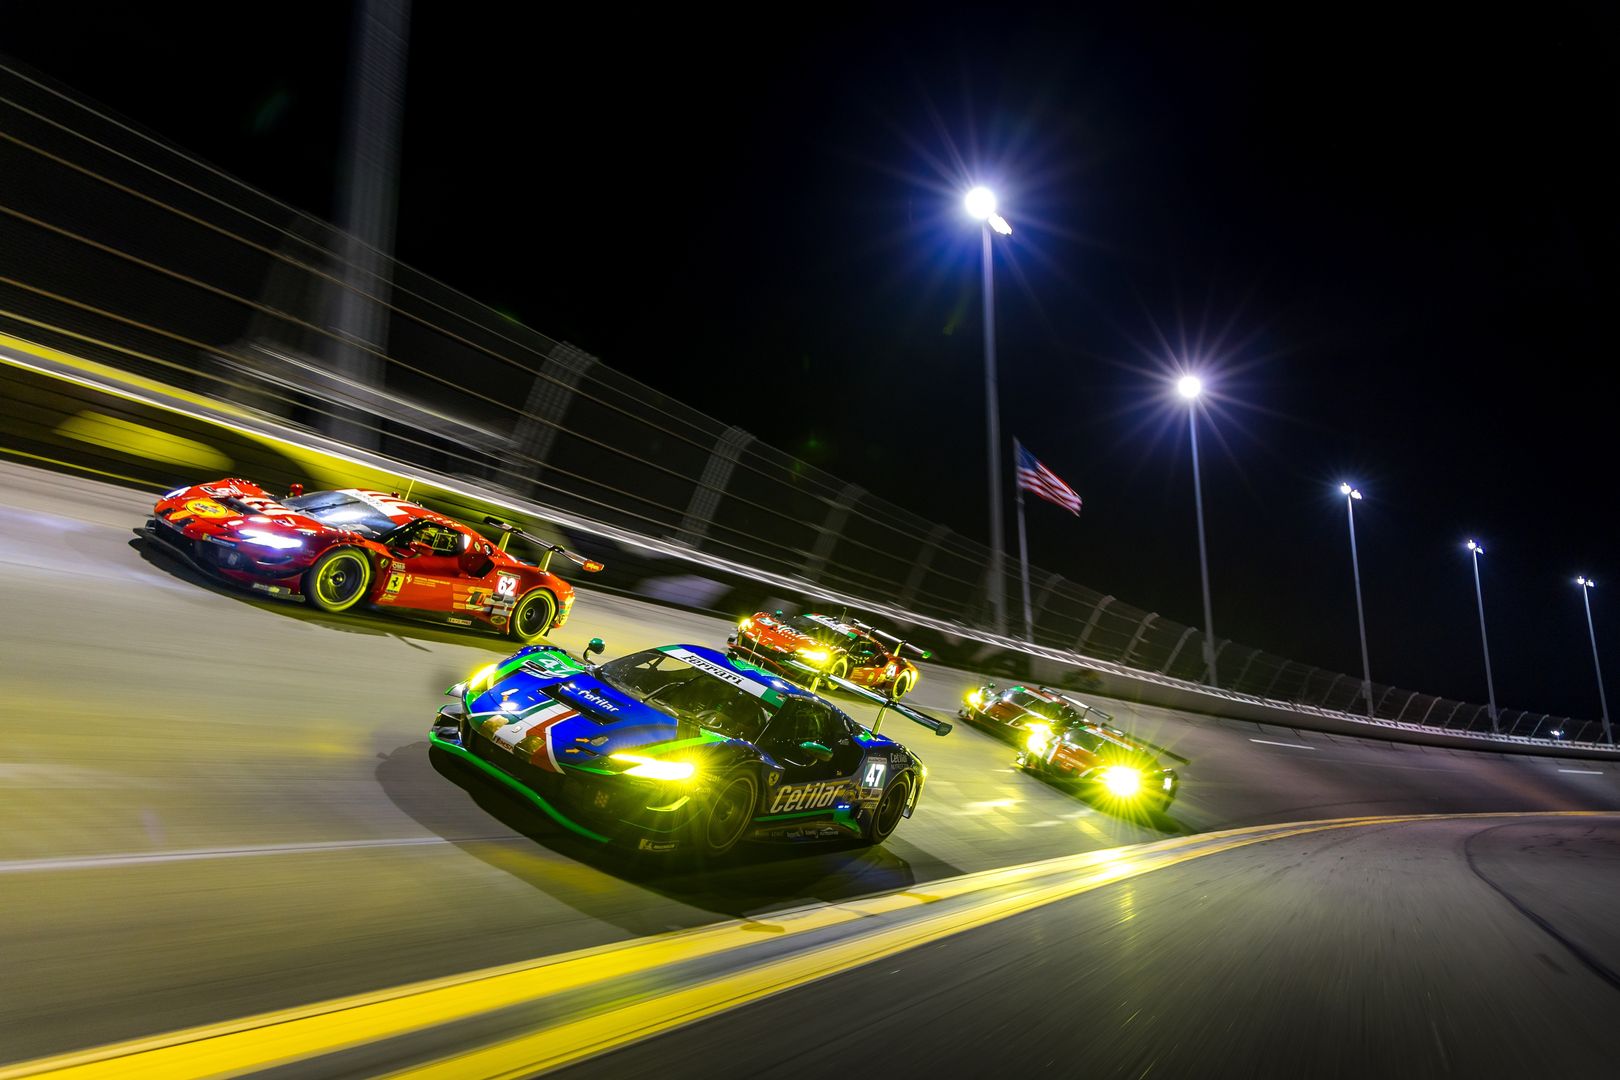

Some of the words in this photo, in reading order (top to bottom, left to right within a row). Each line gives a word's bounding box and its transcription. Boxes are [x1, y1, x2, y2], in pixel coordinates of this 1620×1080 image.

[497, 576, 517, 597] 62
[538, 658, 577, 674] 47
[681, 654, 745, 686] Ferrari
[865, 763, 886, 787] 47
[769, 781, 845, 814] Cetilar
